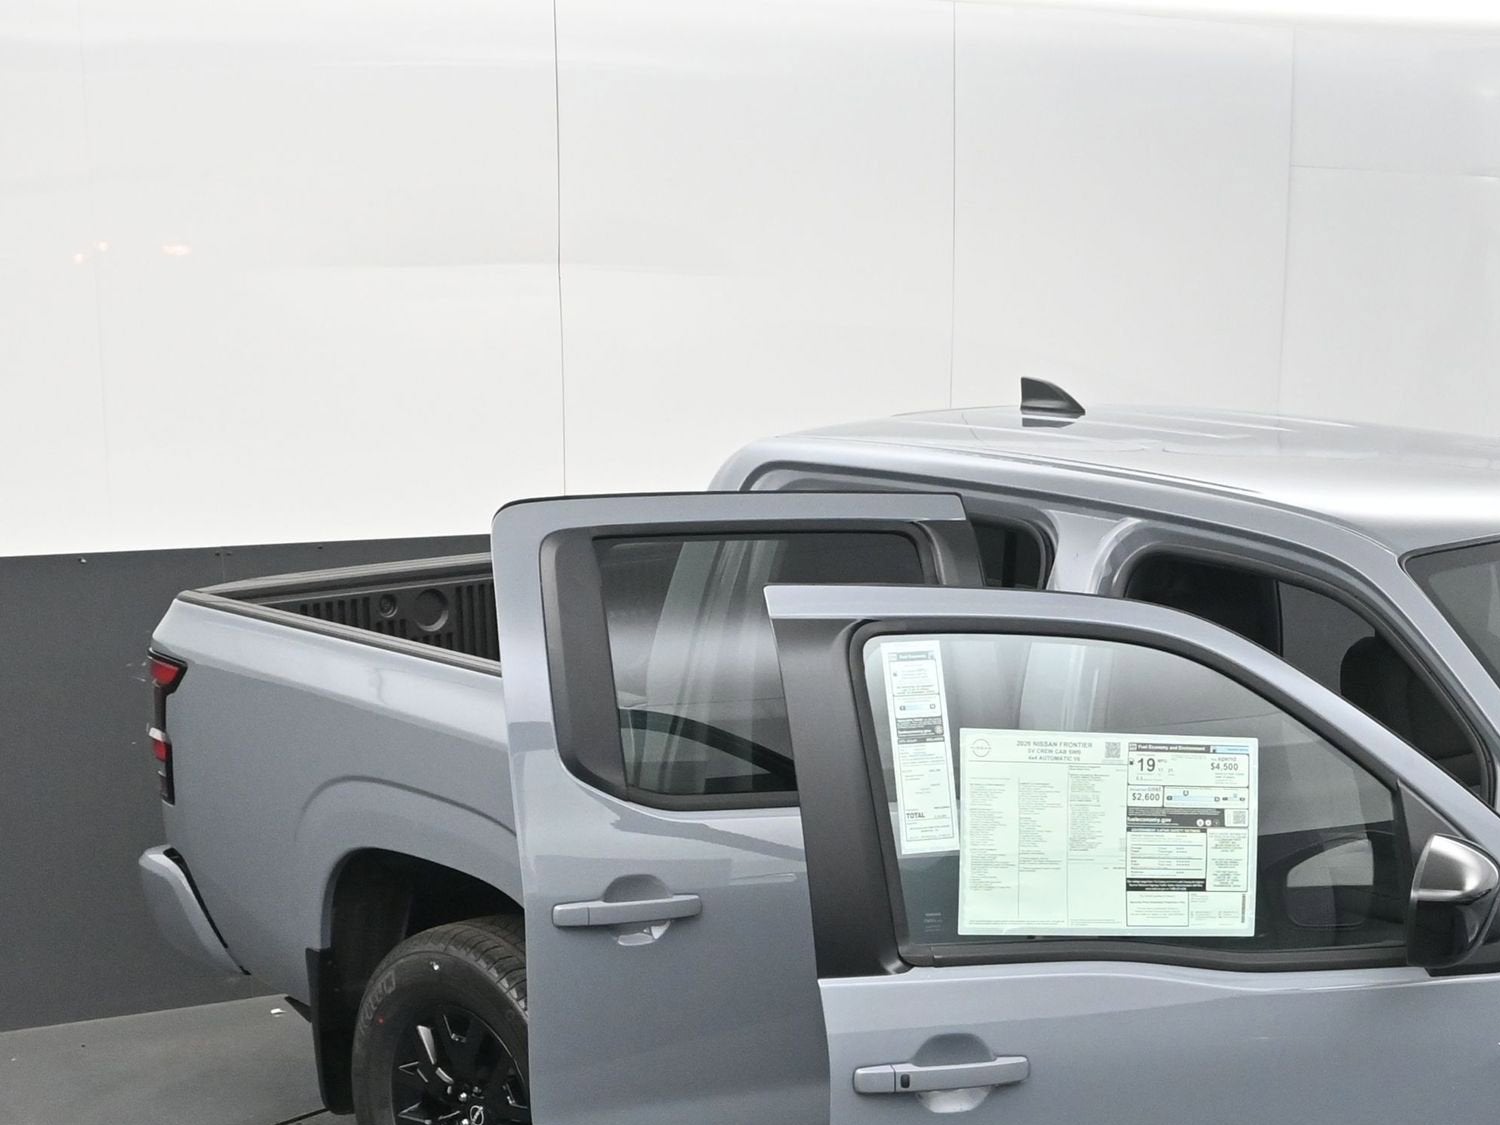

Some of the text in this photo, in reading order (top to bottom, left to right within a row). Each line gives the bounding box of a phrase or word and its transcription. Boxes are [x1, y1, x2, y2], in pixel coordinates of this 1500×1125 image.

[1059, 741, 1093, 749] FRONTIER
[1137, 757, 1156, 772] 19
[1210, 762, 1239, 771] $4,500
[1131, 792, 1160, 801] $2,600
